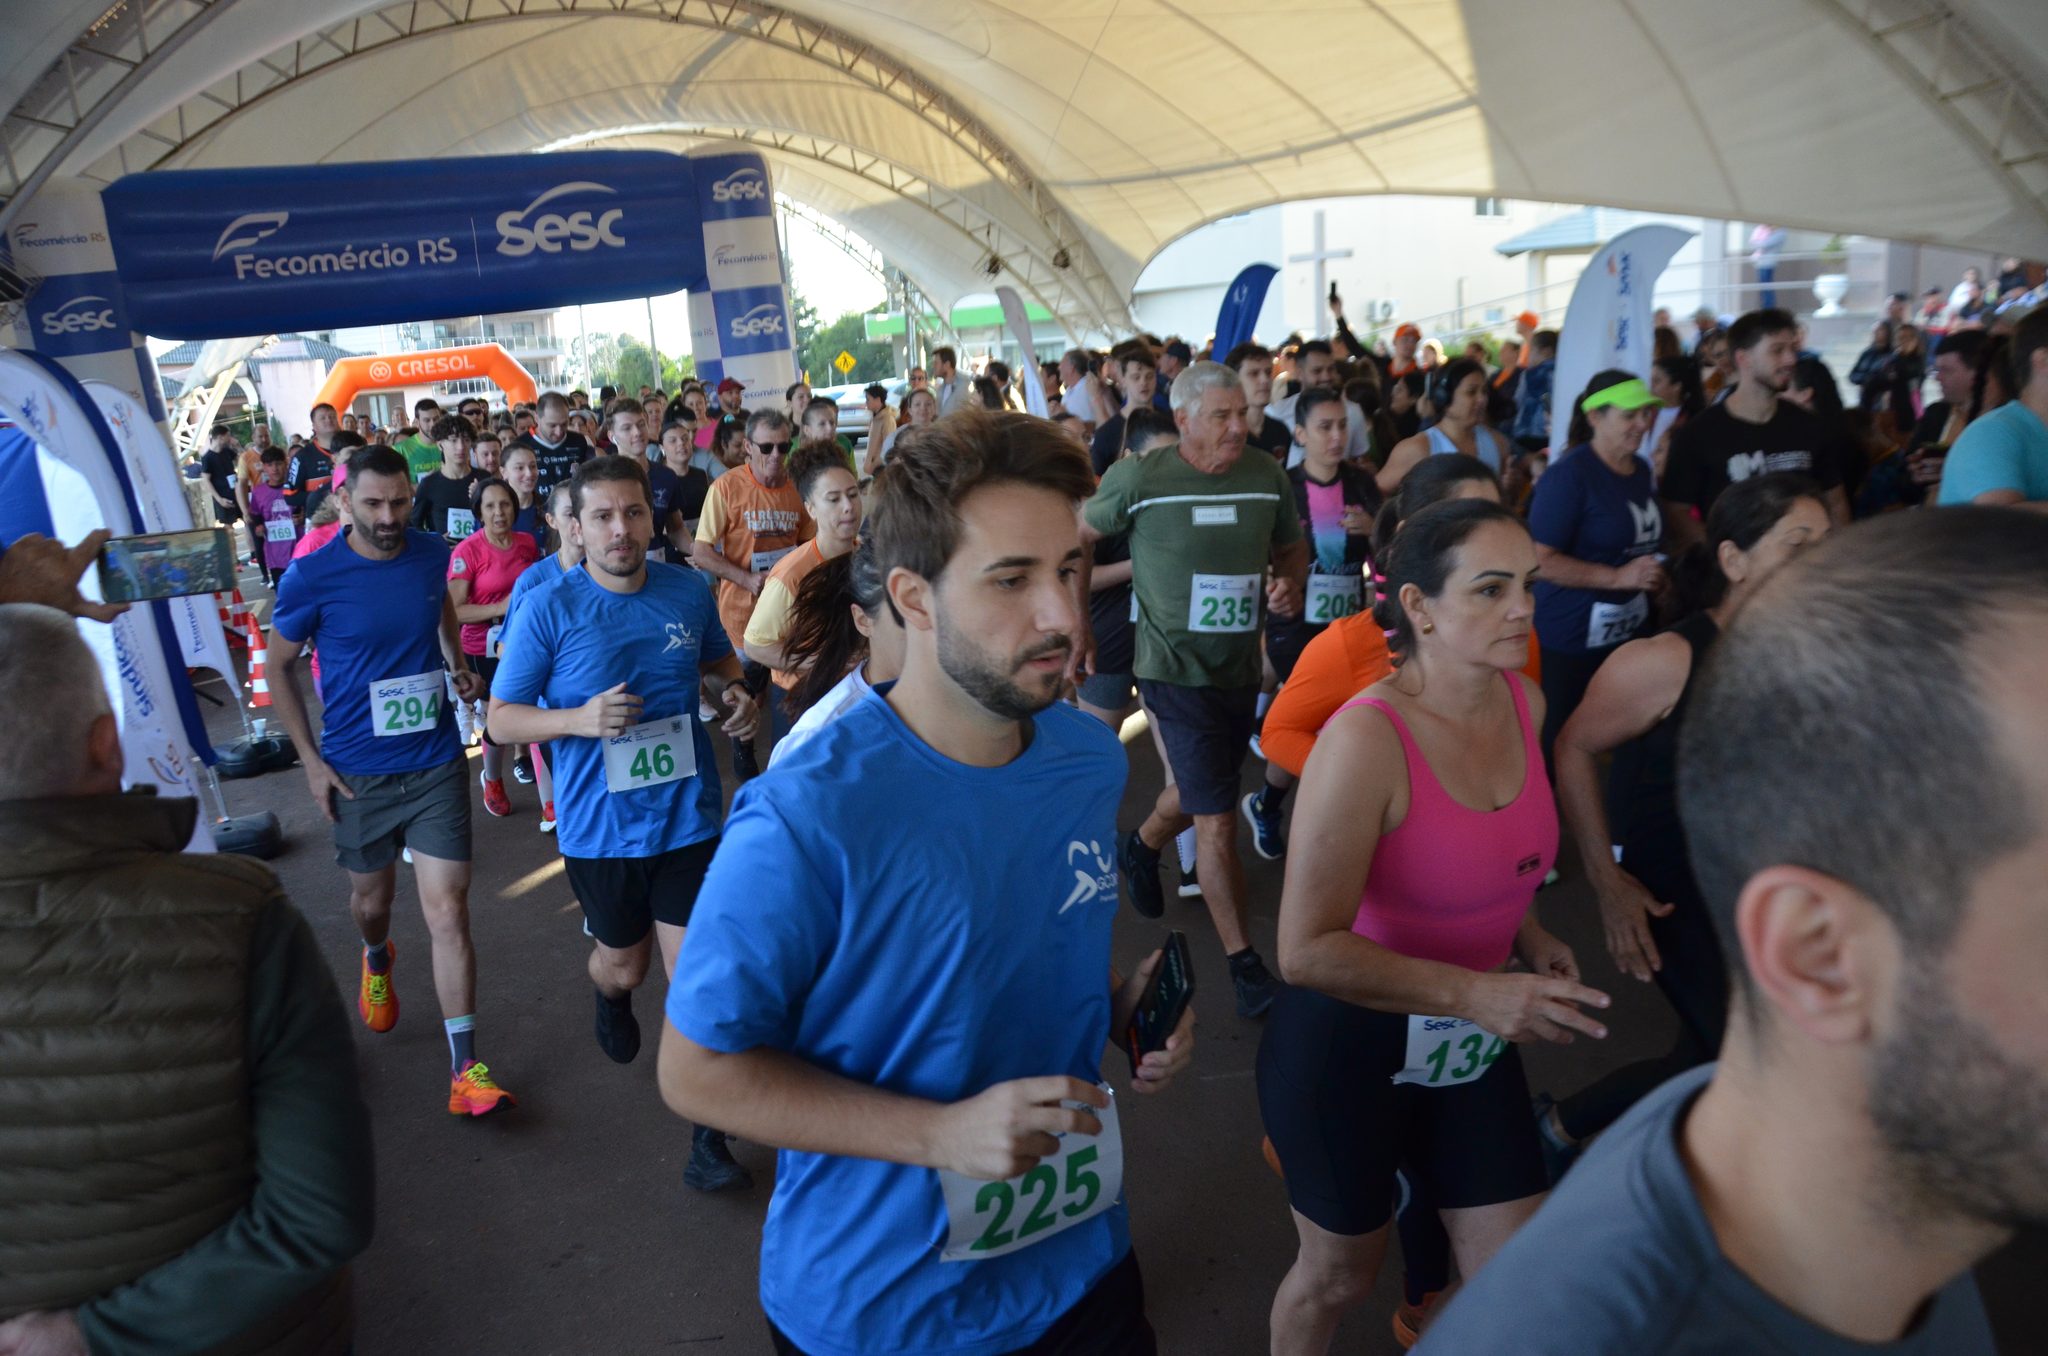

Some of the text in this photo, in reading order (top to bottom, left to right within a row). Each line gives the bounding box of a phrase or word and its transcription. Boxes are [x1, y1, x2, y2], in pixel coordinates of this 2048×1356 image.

[712, 177, 766, 202] Sesc
[19, 233, 88, 249] Fecomércio
[495, 207, 627, 258] Sesc
[234, 236, 459, 281] Fecomércio RS
[41, 308, 117, 336] Sesc
[730, 314, 784, 338] Sesc
[397, 354, 473, 377] CRESOL
[271, 527, 292, 540] 169
[452, 519, 474, 537] 36
[1199, 595, 1253, 628] 235
[378, 686, 405, 699] Sesc
[383, 691, 441, 731] 294
[609, 735, 632, 746] Sesc
[630, 743, 675, 781] 46
[1424, 1018, 1457, 1031] Sesc
[1425, 1033, 1507, 1083] 134
[968, 1143, 1101, 1252] 225
